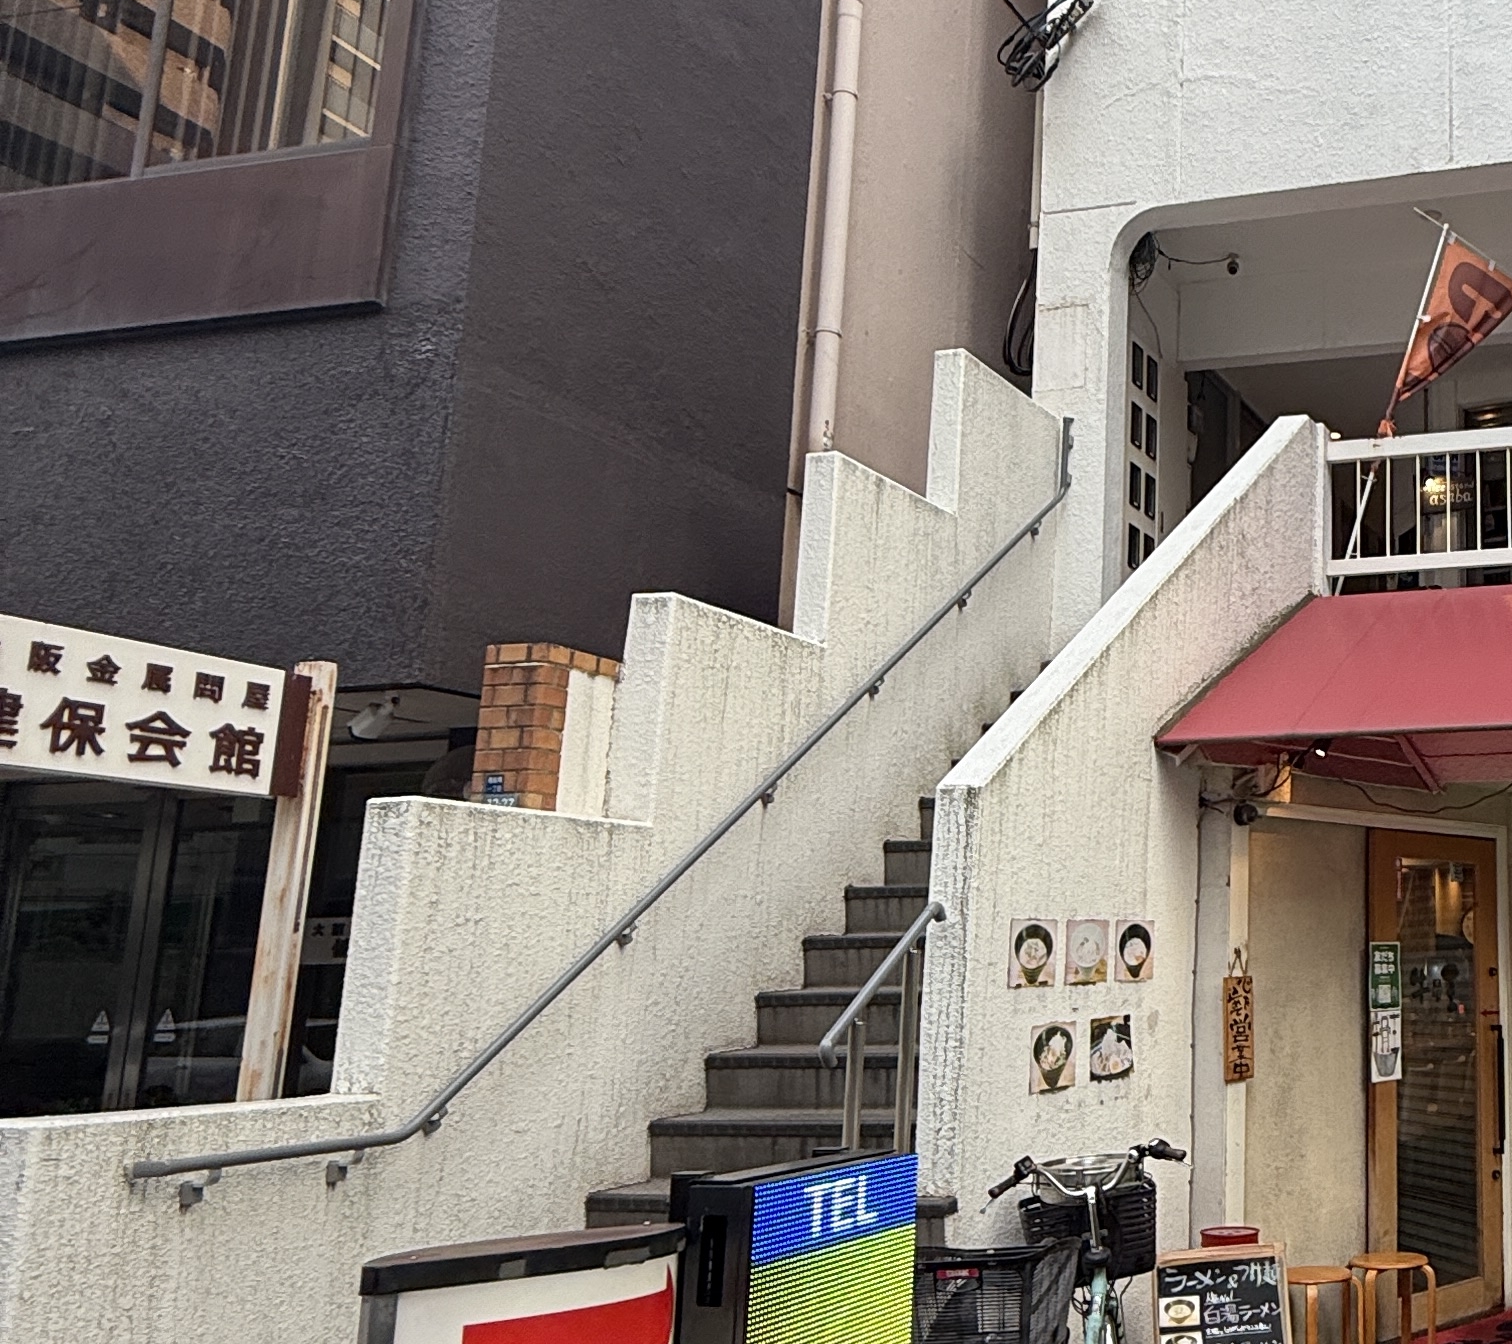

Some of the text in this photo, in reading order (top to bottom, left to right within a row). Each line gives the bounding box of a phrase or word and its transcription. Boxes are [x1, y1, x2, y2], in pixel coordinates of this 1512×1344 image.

[804, 1174, 879, 1238] TEL
[1203, 1302, 1281, 1324] 白湯ラーメン
